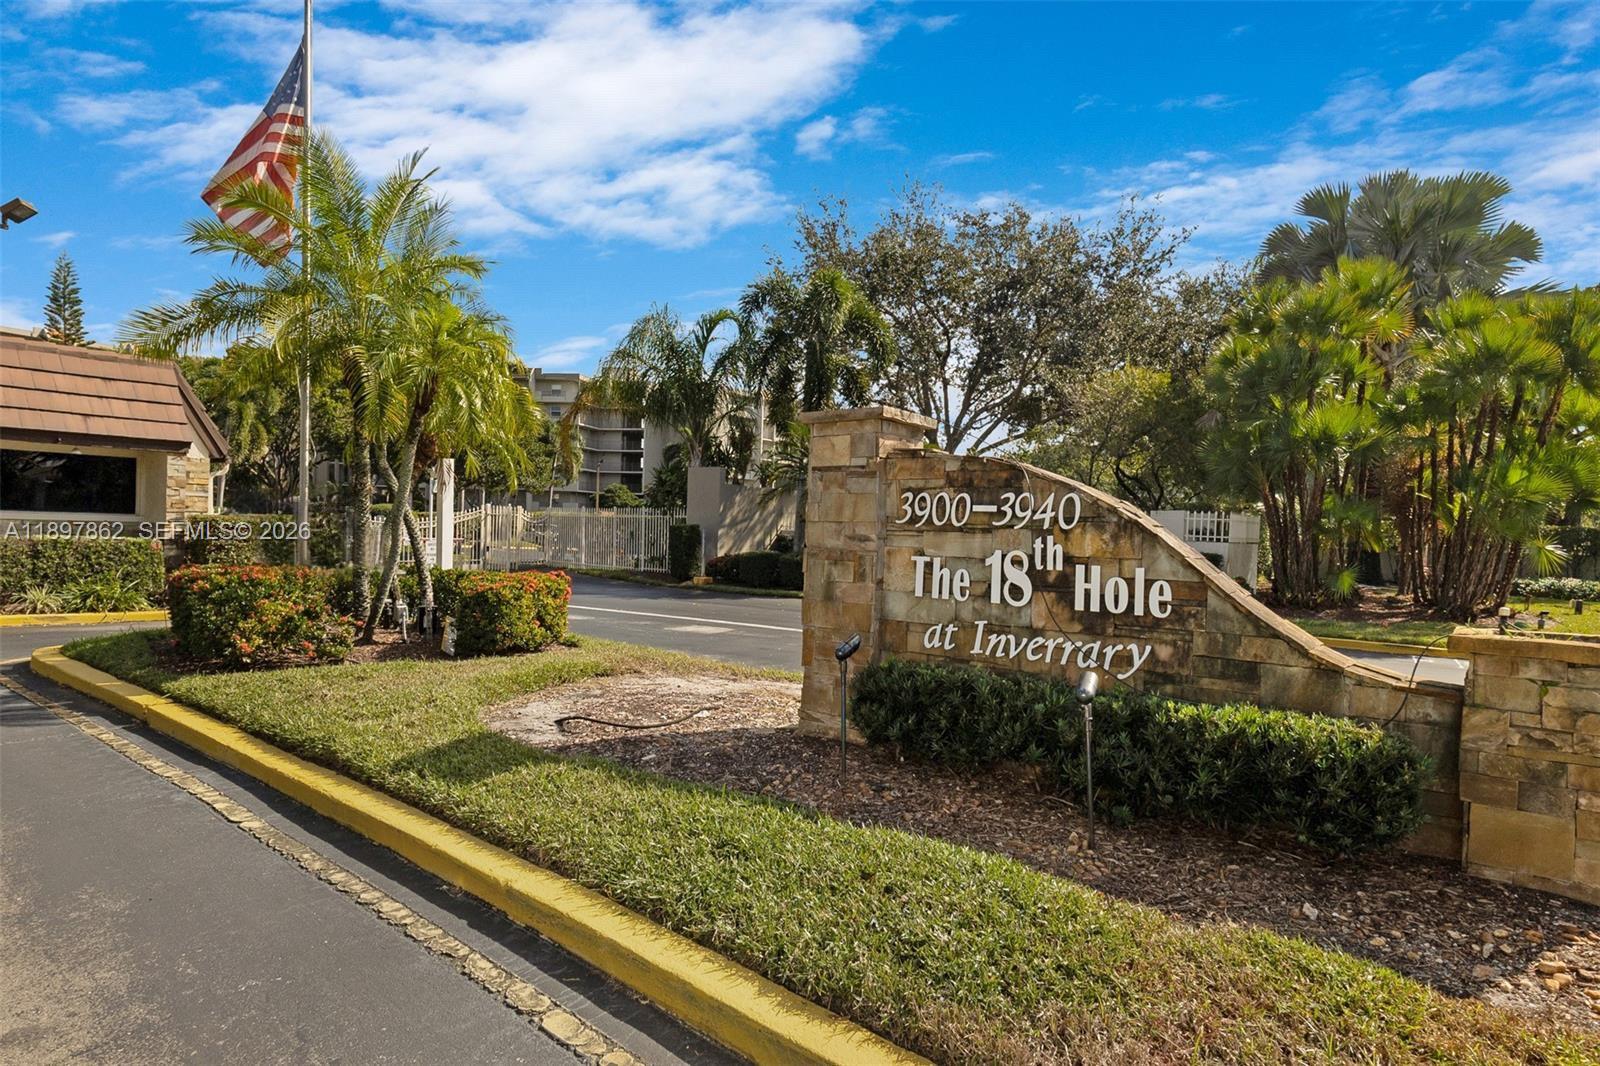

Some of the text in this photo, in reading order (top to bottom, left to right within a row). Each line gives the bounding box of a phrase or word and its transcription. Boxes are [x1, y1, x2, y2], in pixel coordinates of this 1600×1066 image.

[911, 555, 970, 602] The
[1074, 564, 1173, 619] Hole
[923, 620, 1152, 680] at Inverrary
